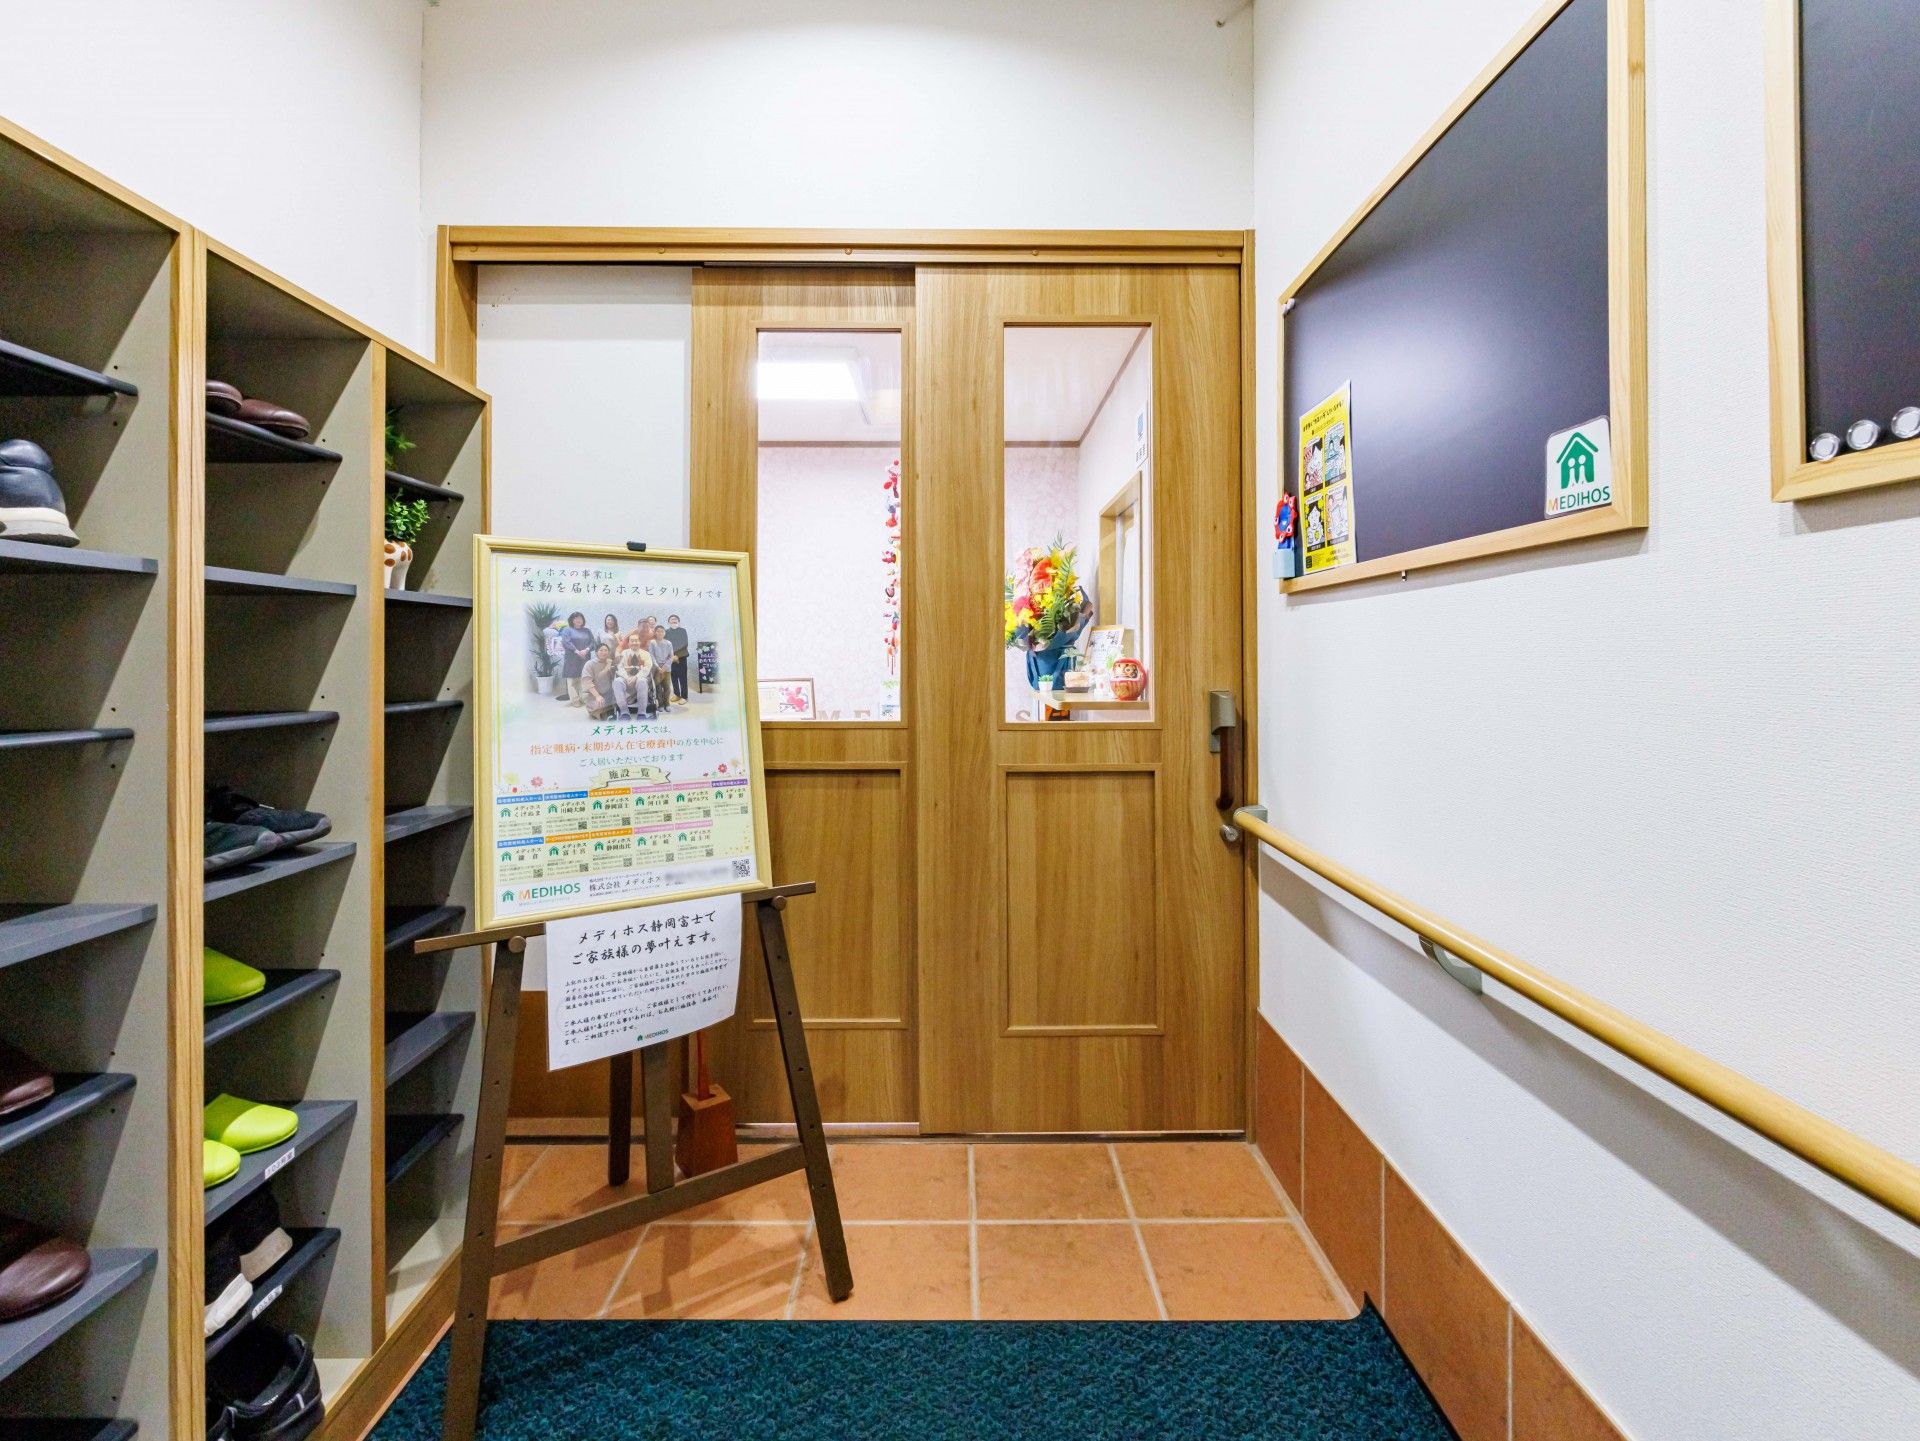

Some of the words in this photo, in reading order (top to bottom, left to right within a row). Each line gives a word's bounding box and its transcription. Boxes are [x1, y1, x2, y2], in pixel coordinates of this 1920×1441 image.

[1548, 486, 1610, 512] MEDIHOS
[510, 566, 613, 580] メディホスの事業は
[522, 579, 723, 599] 感動を届けるホスピタリティです
[609, 768, 650, 779] 施設一覧
[518, 883, 581, 900] MEDIHOS
[589, 881, 620, 891] 株式会社
[625, 876, 661, 886] メディホス
[579, 911, 716, 944] メディホス静岡富士で
[572, 931, 717, 965] ご家族様の夢叶えます。
[644, 1028, 669, 1039] MEDIHOS
